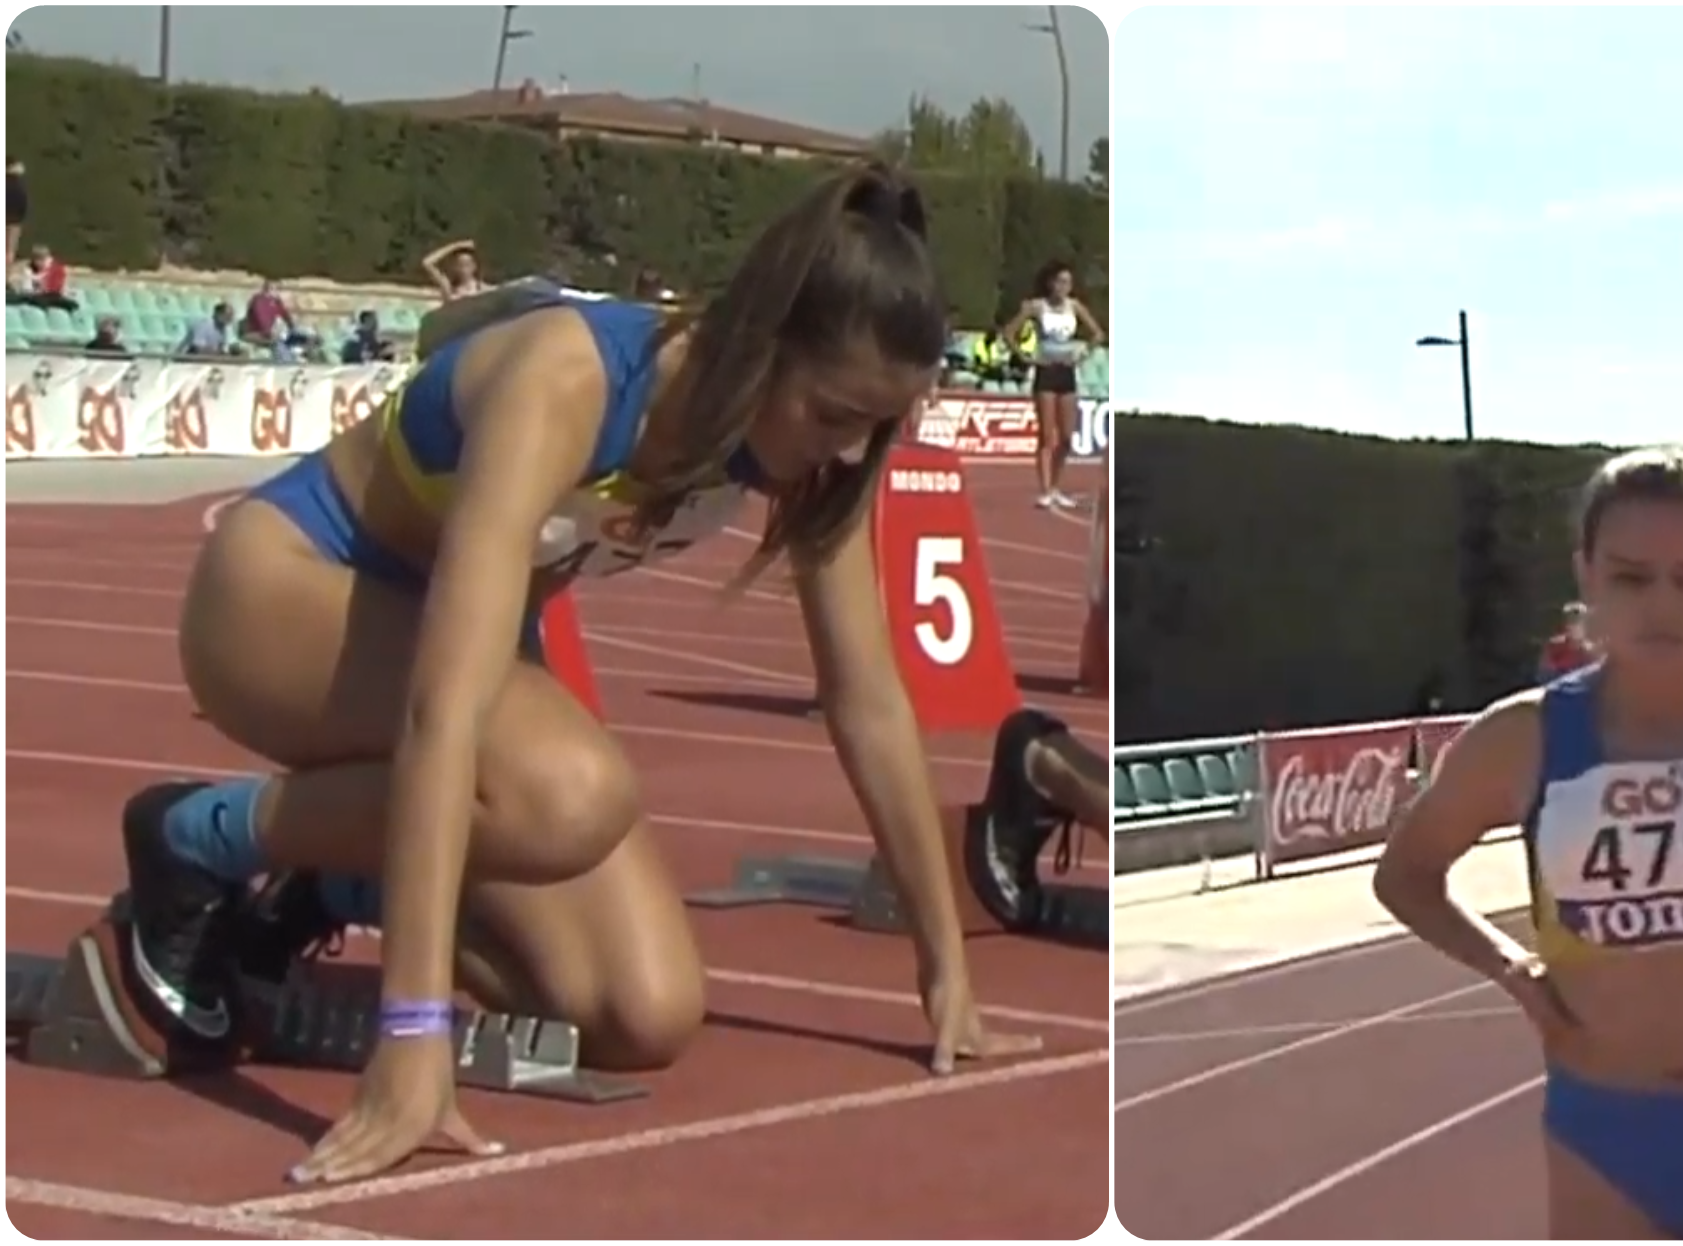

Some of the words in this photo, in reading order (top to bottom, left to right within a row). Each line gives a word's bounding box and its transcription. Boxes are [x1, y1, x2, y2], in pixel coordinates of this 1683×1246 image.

[252, 386, 292, 450] GO
[890, 470, 962, 493] MONDO
[913, 536, 973, 665] 5
[1602, 776, 1683, 818] GO
